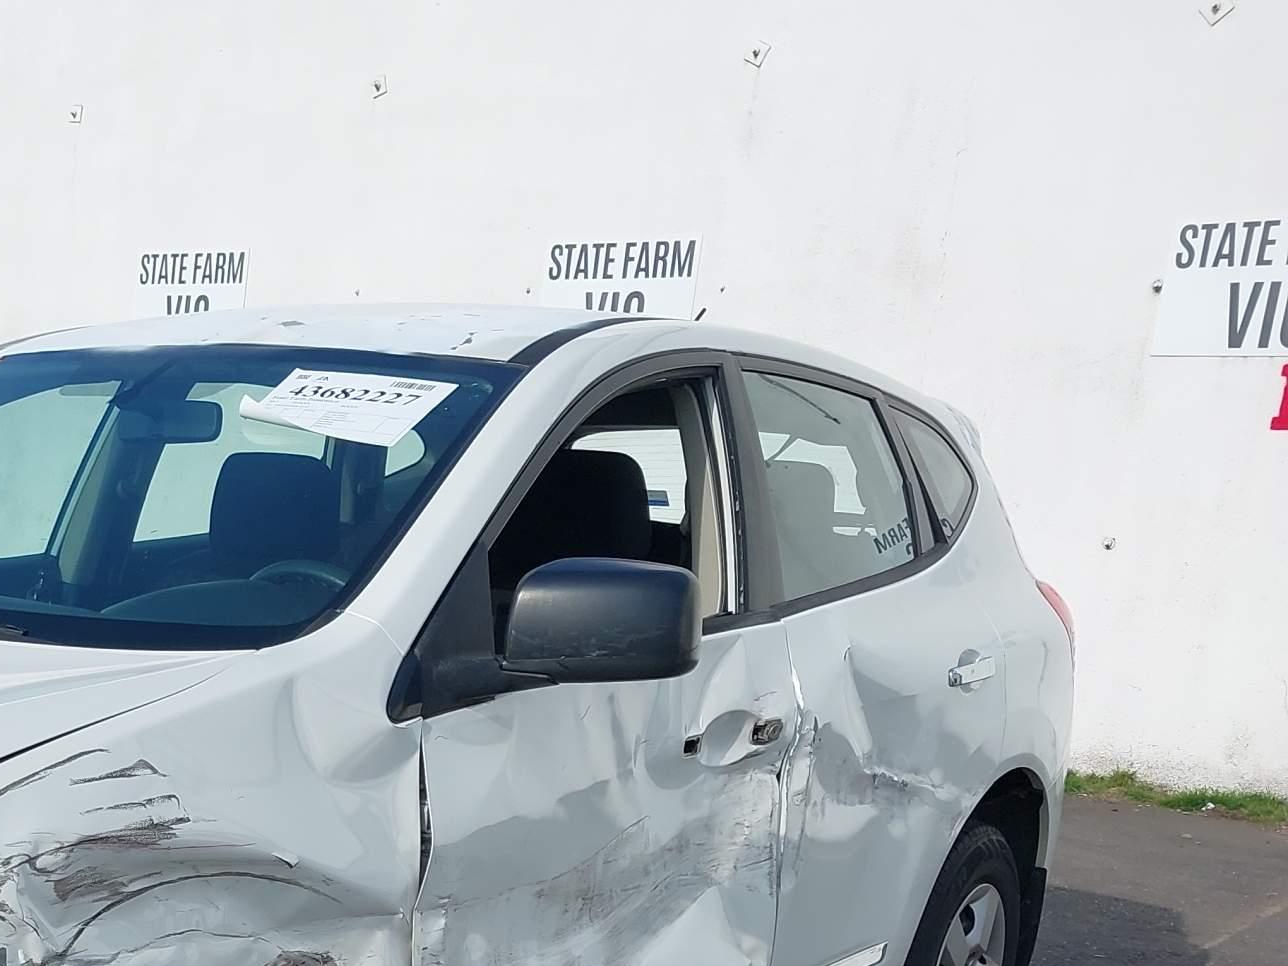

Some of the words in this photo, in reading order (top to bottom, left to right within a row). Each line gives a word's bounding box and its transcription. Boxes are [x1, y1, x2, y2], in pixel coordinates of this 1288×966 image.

[548, 242, 618, 281] STATE
[621, 239, 697, 280] FARM
[1175, 219, 1281, 269] STATE
[139, 253, 189, 285] STATE
[192, 251, 245, 285] FARM
[289, 384, 423, 406] 43682227
